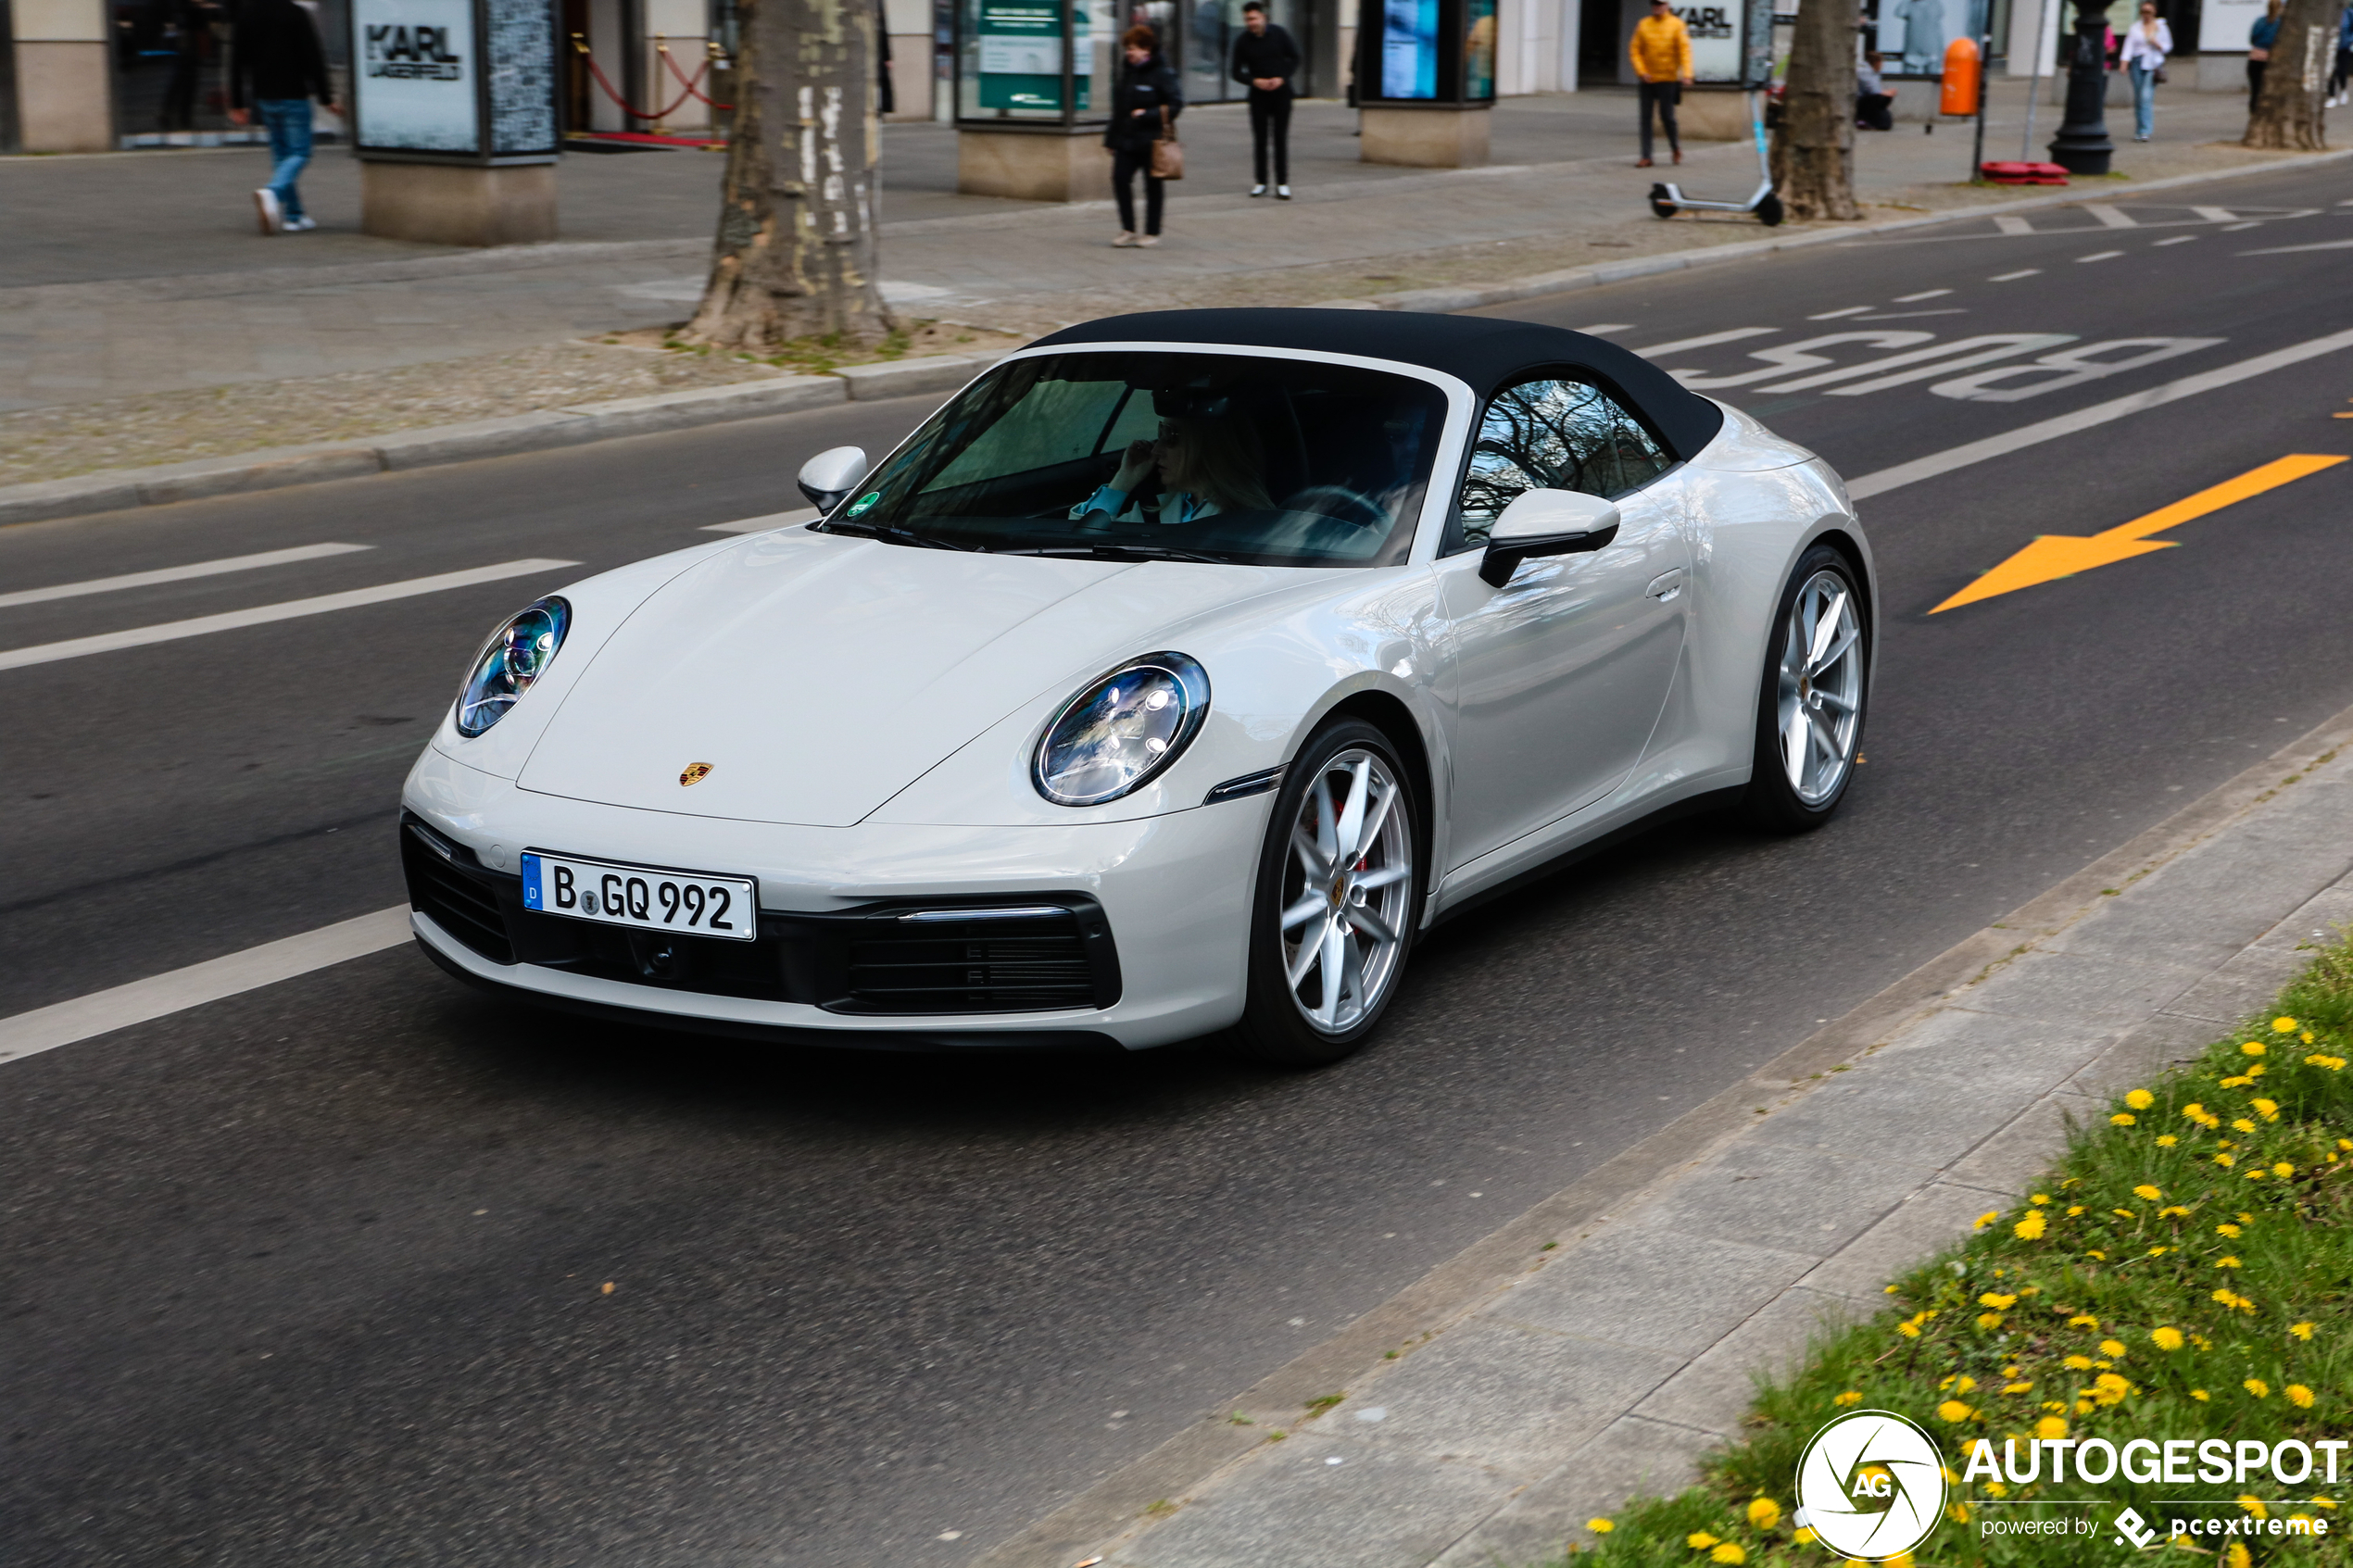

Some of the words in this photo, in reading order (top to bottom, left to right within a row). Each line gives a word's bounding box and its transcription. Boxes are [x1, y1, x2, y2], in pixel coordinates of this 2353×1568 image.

[367, 25, 460, 62] KARL
[1665, 330, 2230, 402] BUS
[529, 887, 537, 899] D
[554, 865, 576, 909] B
[601, 873, 650, 921] GQ
[658, 881, 733, 930] 992
